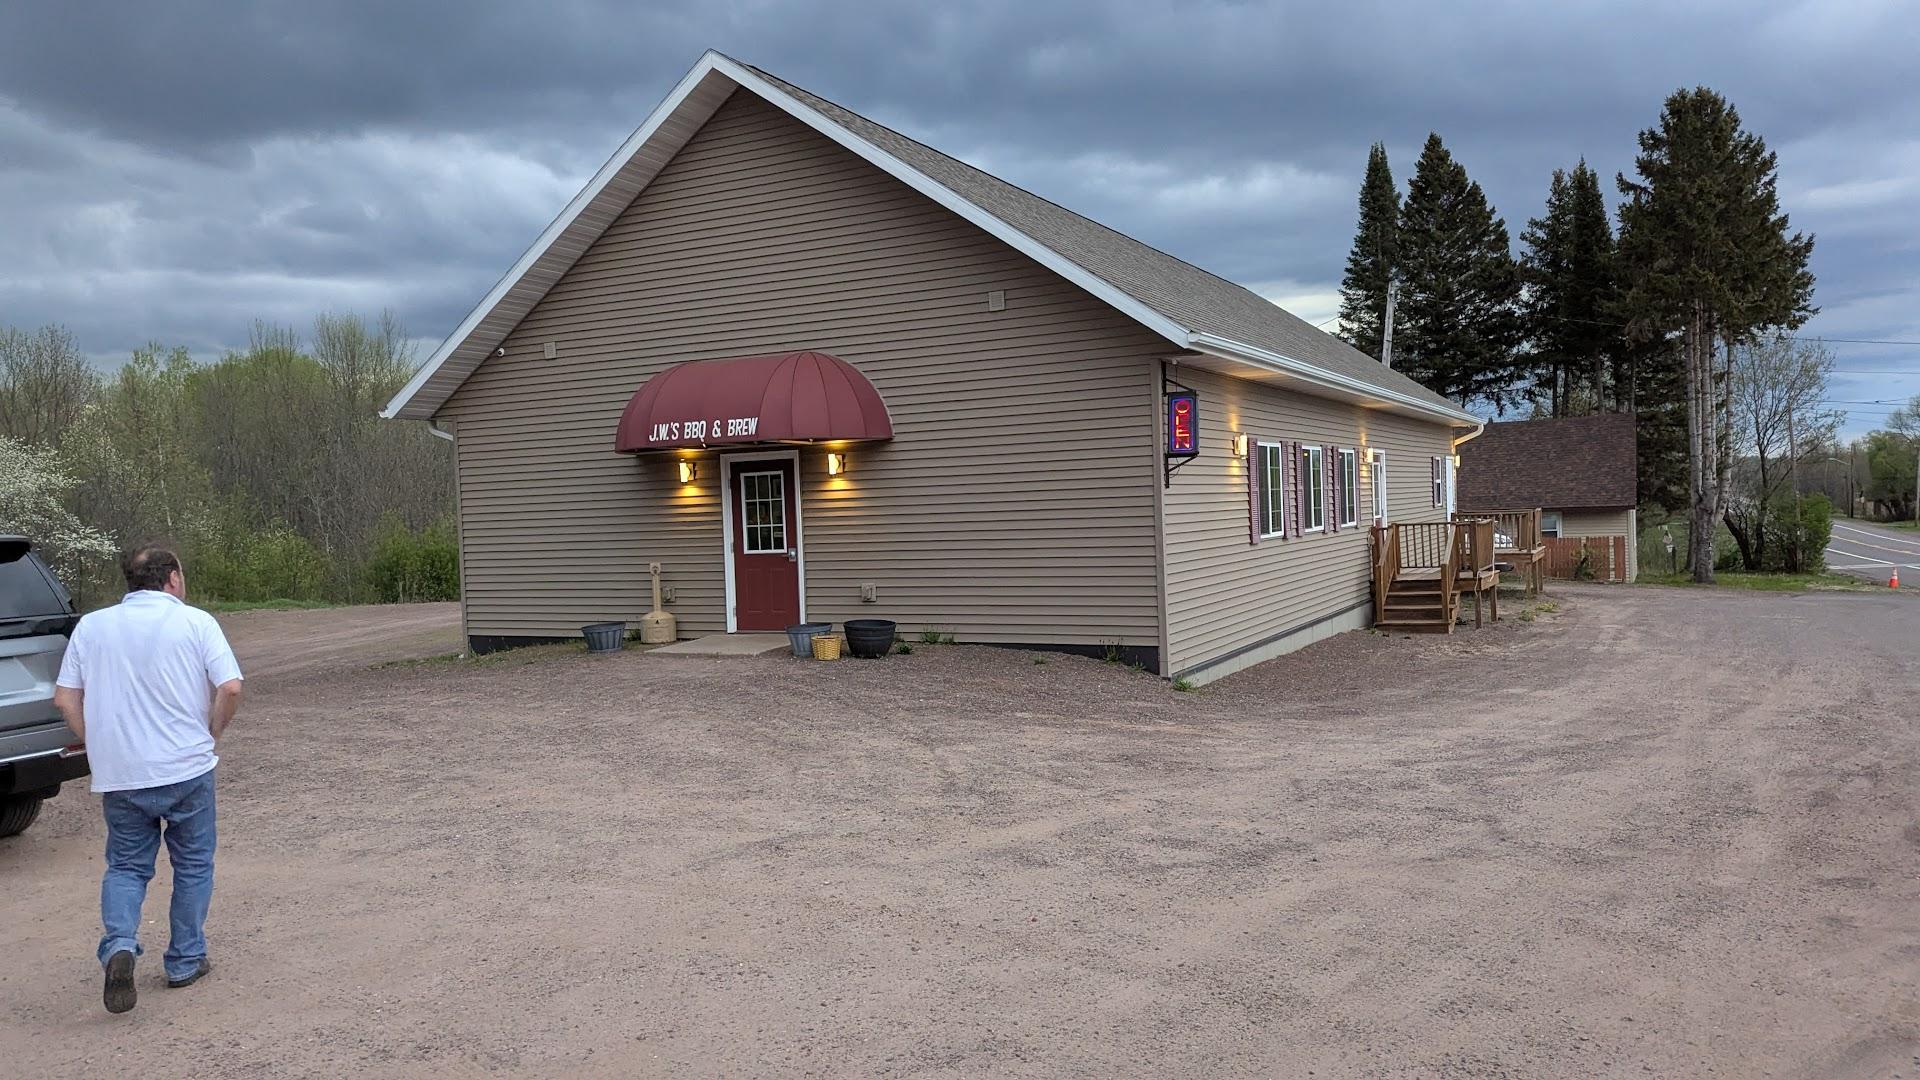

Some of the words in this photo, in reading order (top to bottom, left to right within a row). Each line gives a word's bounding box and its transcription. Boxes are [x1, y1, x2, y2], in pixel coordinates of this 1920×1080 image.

[649, 422, 679, 442] J.W.'S
[683, 420, 706, 442] BBQ
[711, 419, 721, 438] &
[727, 417, 758, 436] BREW
